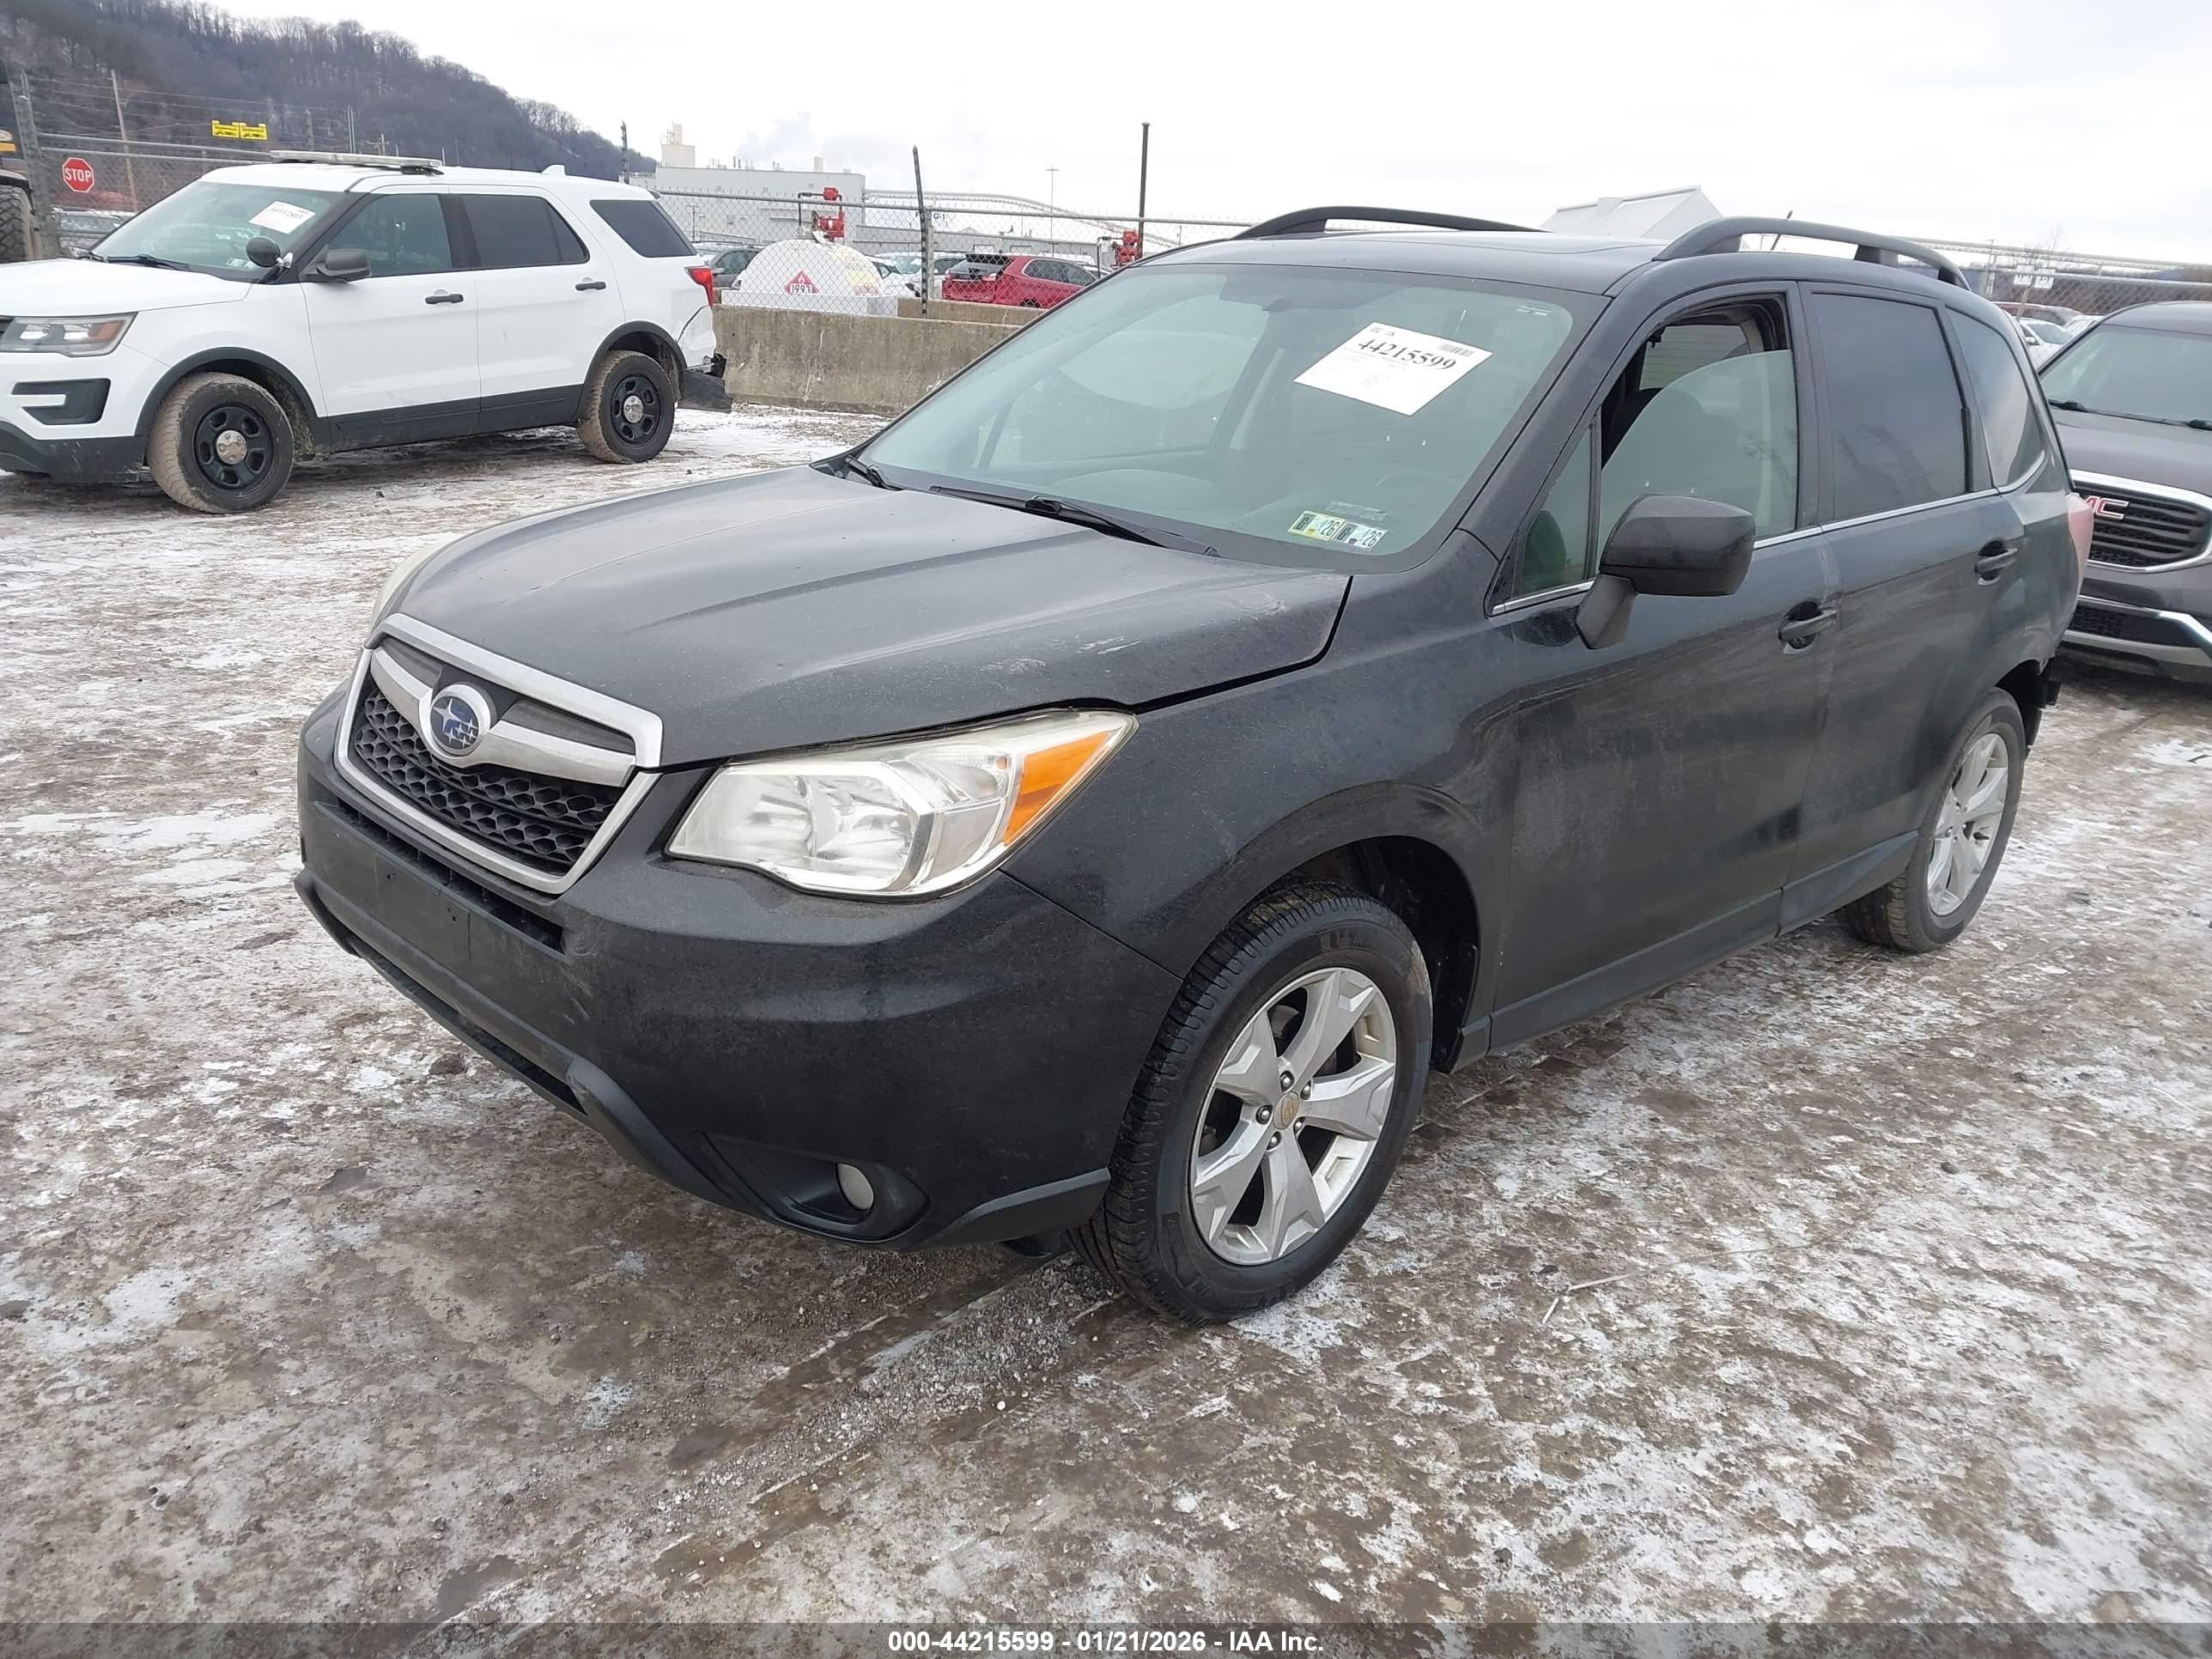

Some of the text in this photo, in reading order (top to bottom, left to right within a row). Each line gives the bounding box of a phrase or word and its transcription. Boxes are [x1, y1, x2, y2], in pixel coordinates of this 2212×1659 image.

[64, 167, 92, 182] STOP
[791, 284, 811, 294] 1993
[1358, 338, 1456, 370] 44215599
